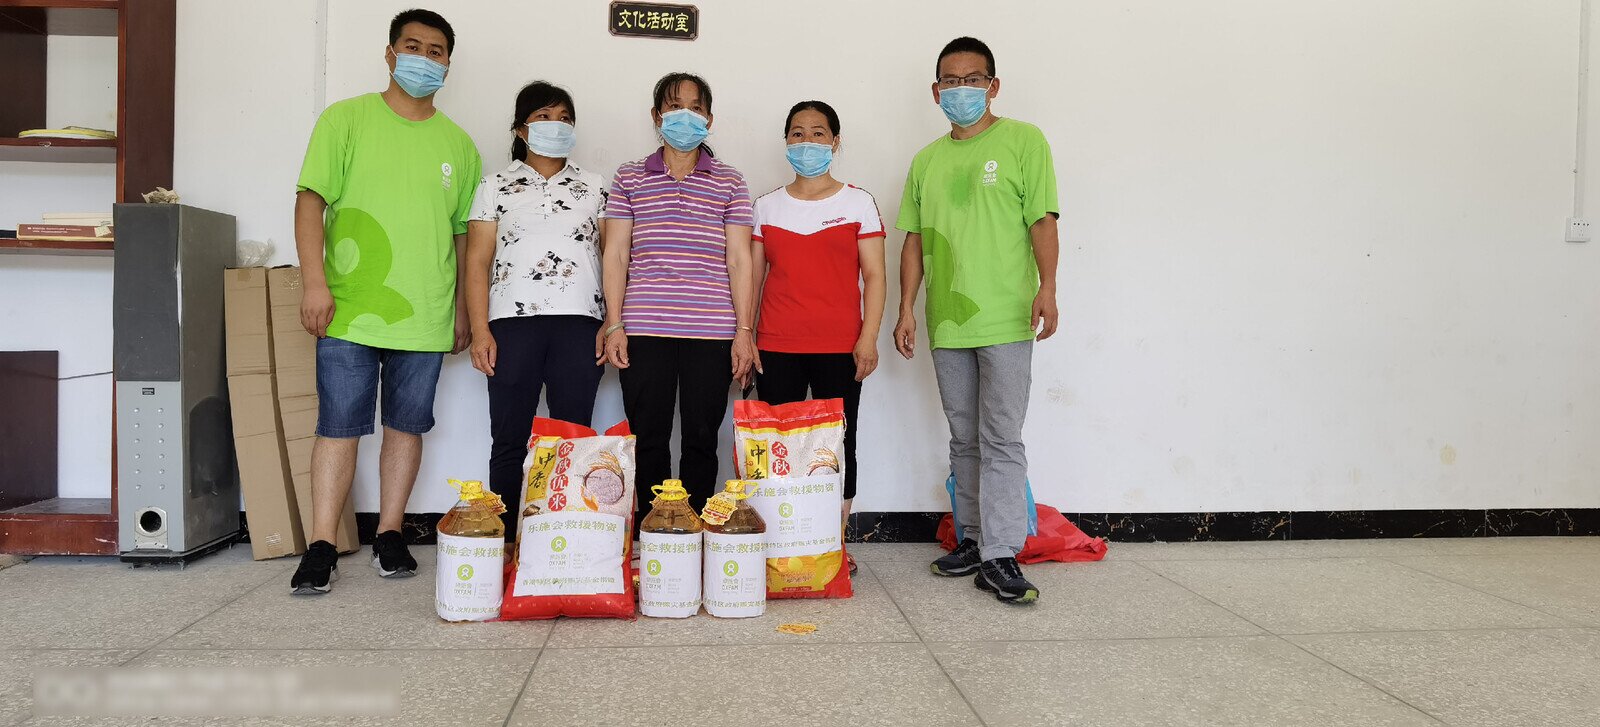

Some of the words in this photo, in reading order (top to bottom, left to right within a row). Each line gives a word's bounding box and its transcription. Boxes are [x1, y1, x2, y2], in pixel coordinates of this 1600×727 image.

[618, 9, 689, 32] 文化活动室
[548, 442, 575, 511] 金秋优米
[753, 483, 834, 497] 乐施会救援物资
[527, 520, 617, 534] 乐施会救援物资
